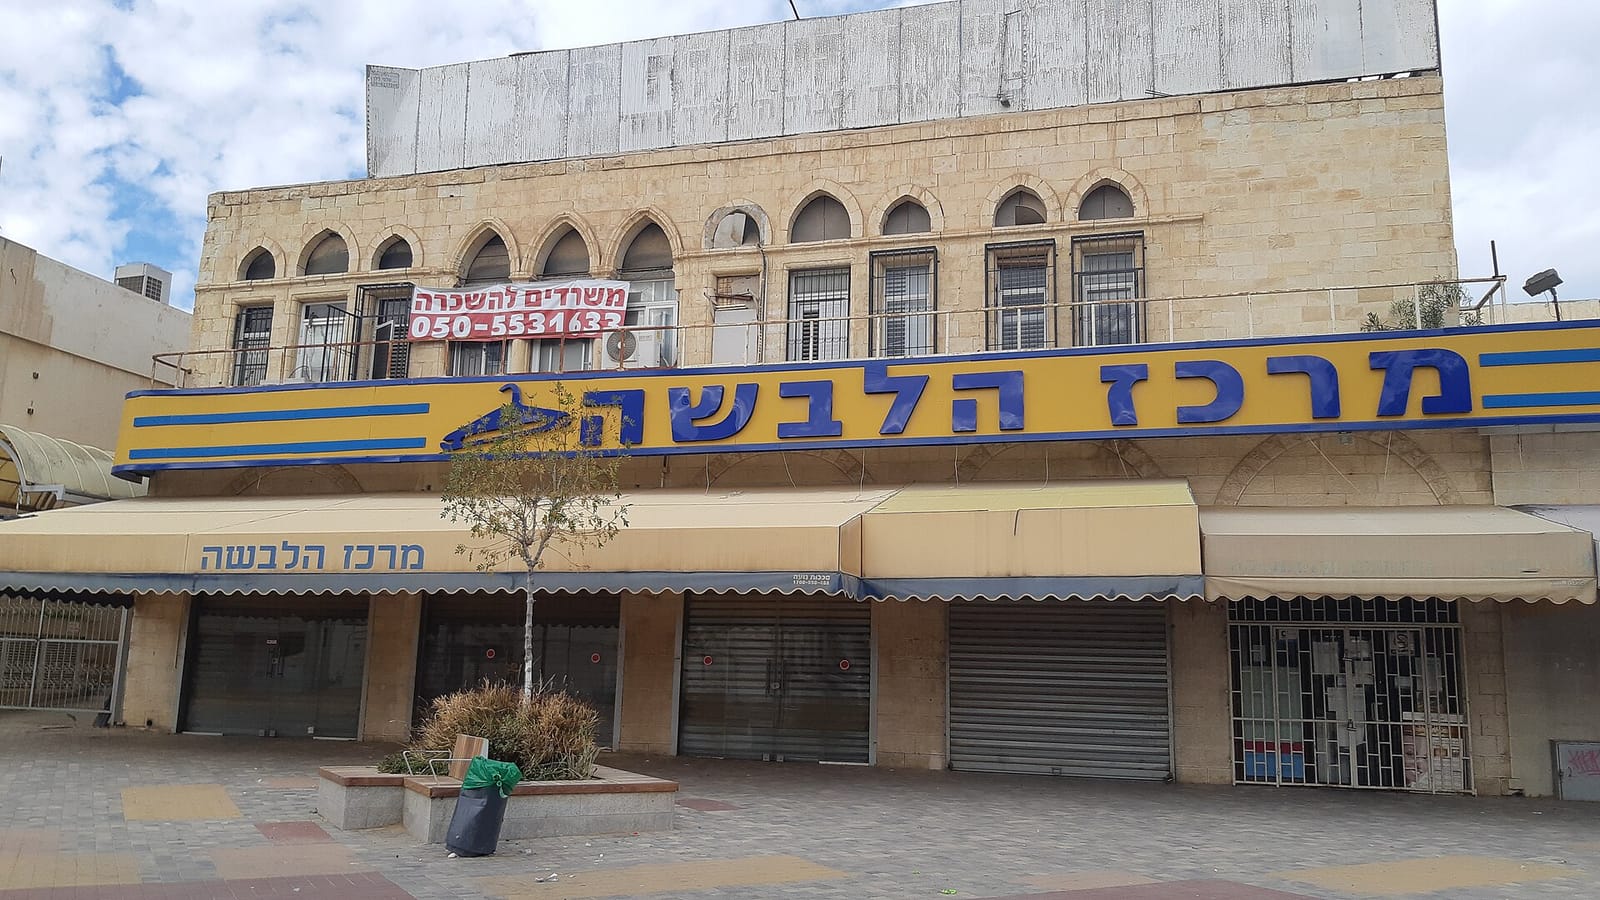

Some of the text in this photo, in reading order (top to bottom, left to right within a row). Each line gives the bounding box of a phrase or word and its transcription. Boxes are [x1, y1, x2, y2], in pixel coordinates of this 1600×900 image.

[414, 285, 625, 312] משרדים להשכרה
[411, 311, 622, 338] 050-5531633
[580, 348, 1472, 447] מרכז הלבשה
[201, 540, 425, 570] מרכז הלבשה
